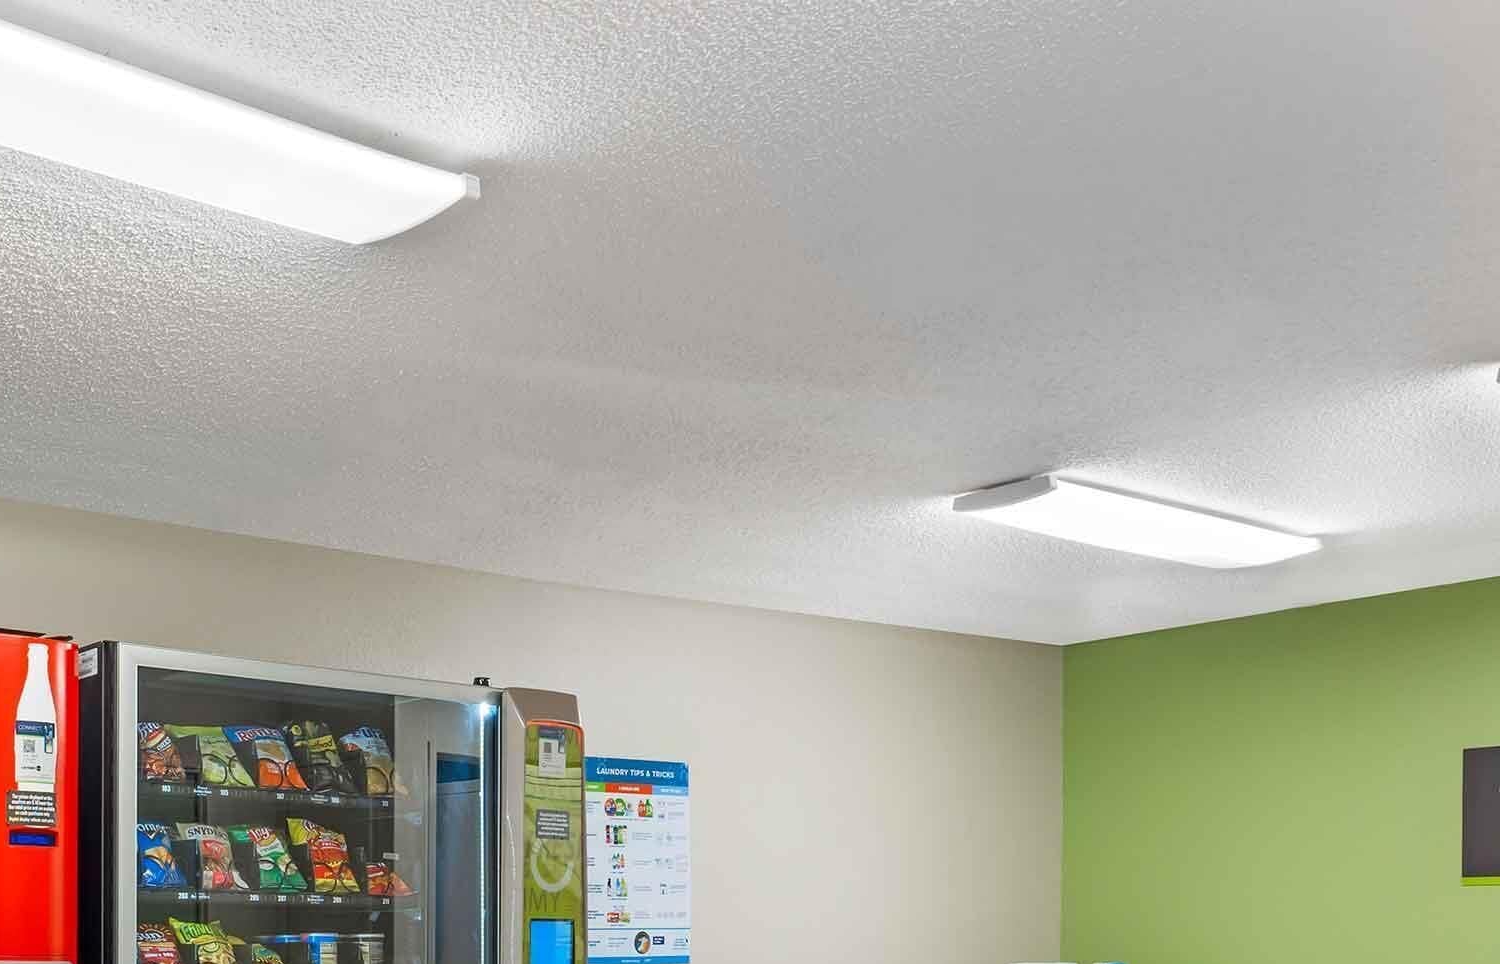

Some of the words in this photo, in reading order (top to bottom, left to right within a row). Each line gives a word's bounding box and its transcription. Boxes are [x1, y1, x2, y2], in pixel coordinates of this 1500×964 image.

[596, 767, 628, 776] LAUNDRY
[630, 769, 644, 777] TIPS
[652, 771, 674, 779] TRICKS
